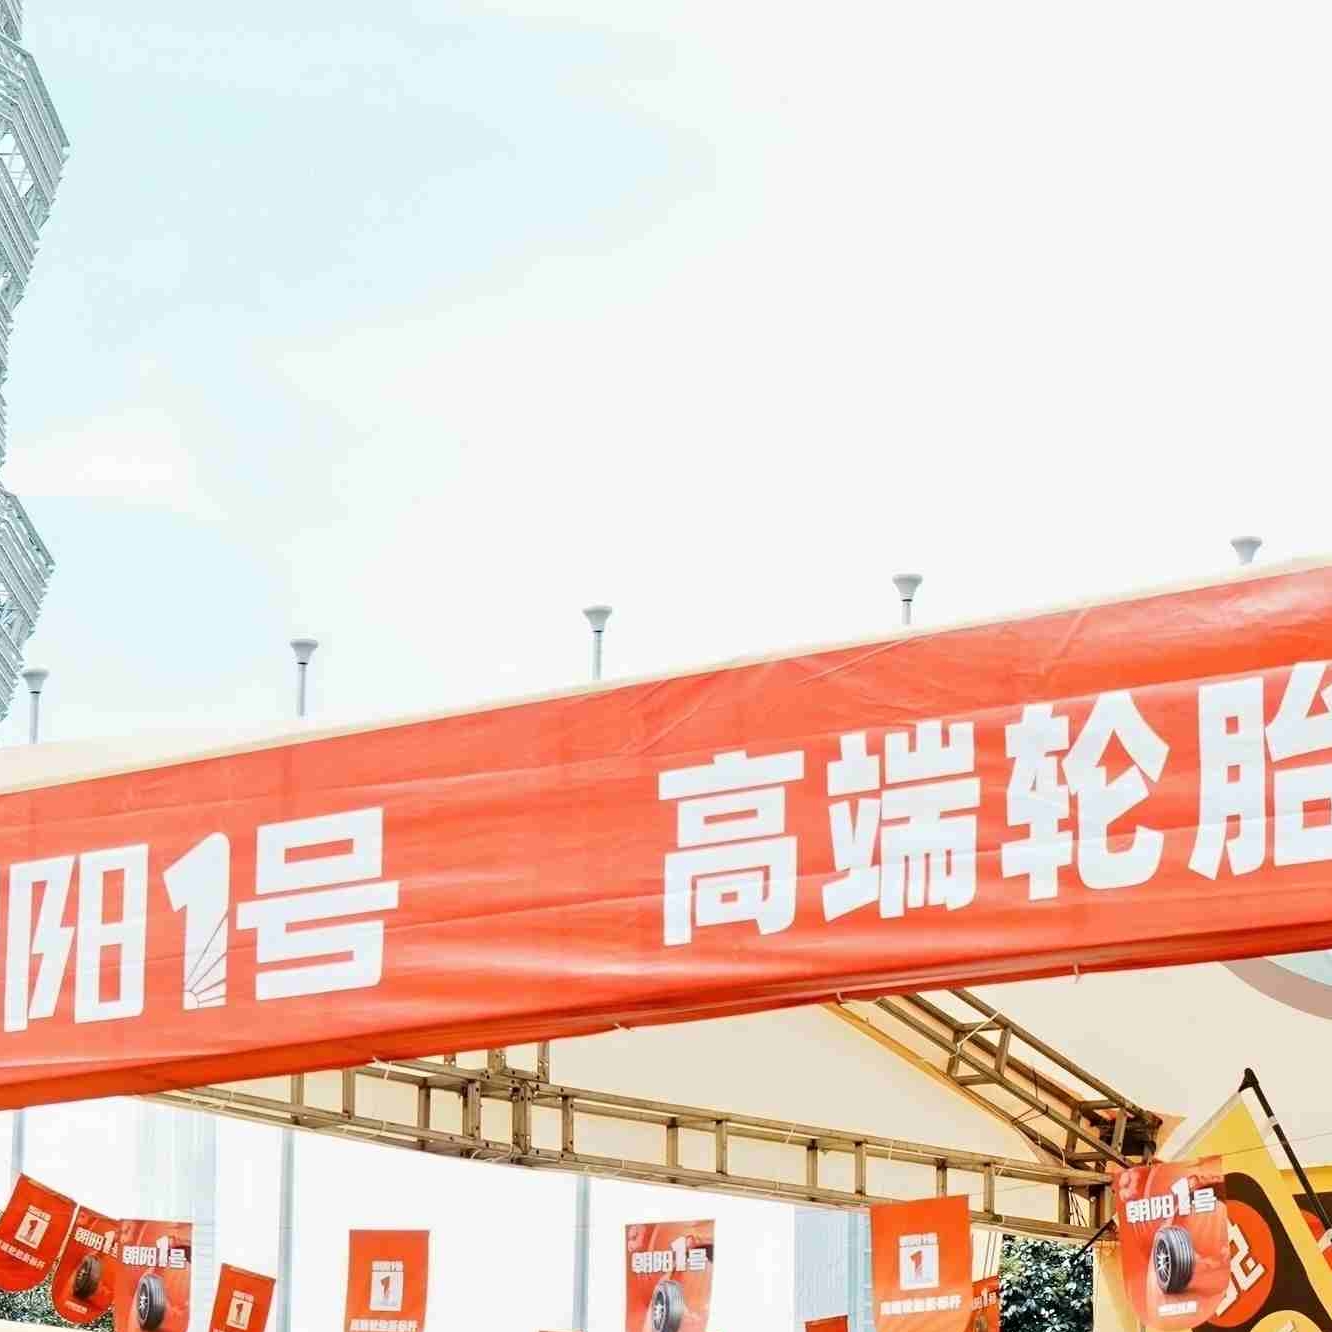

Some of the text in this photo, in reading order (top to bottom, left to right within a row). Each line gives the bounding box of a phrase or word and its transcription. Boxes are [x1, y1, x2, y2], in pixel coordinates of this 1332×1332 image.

[1126, 1176, 1217, 1224] 朝阳1号
[75, 1229, 118, 1259] 朝阳1
[123, 1236, 188, 1269] 朝阳1号
[631, 1235, 709, 1274] 朝阳1号
